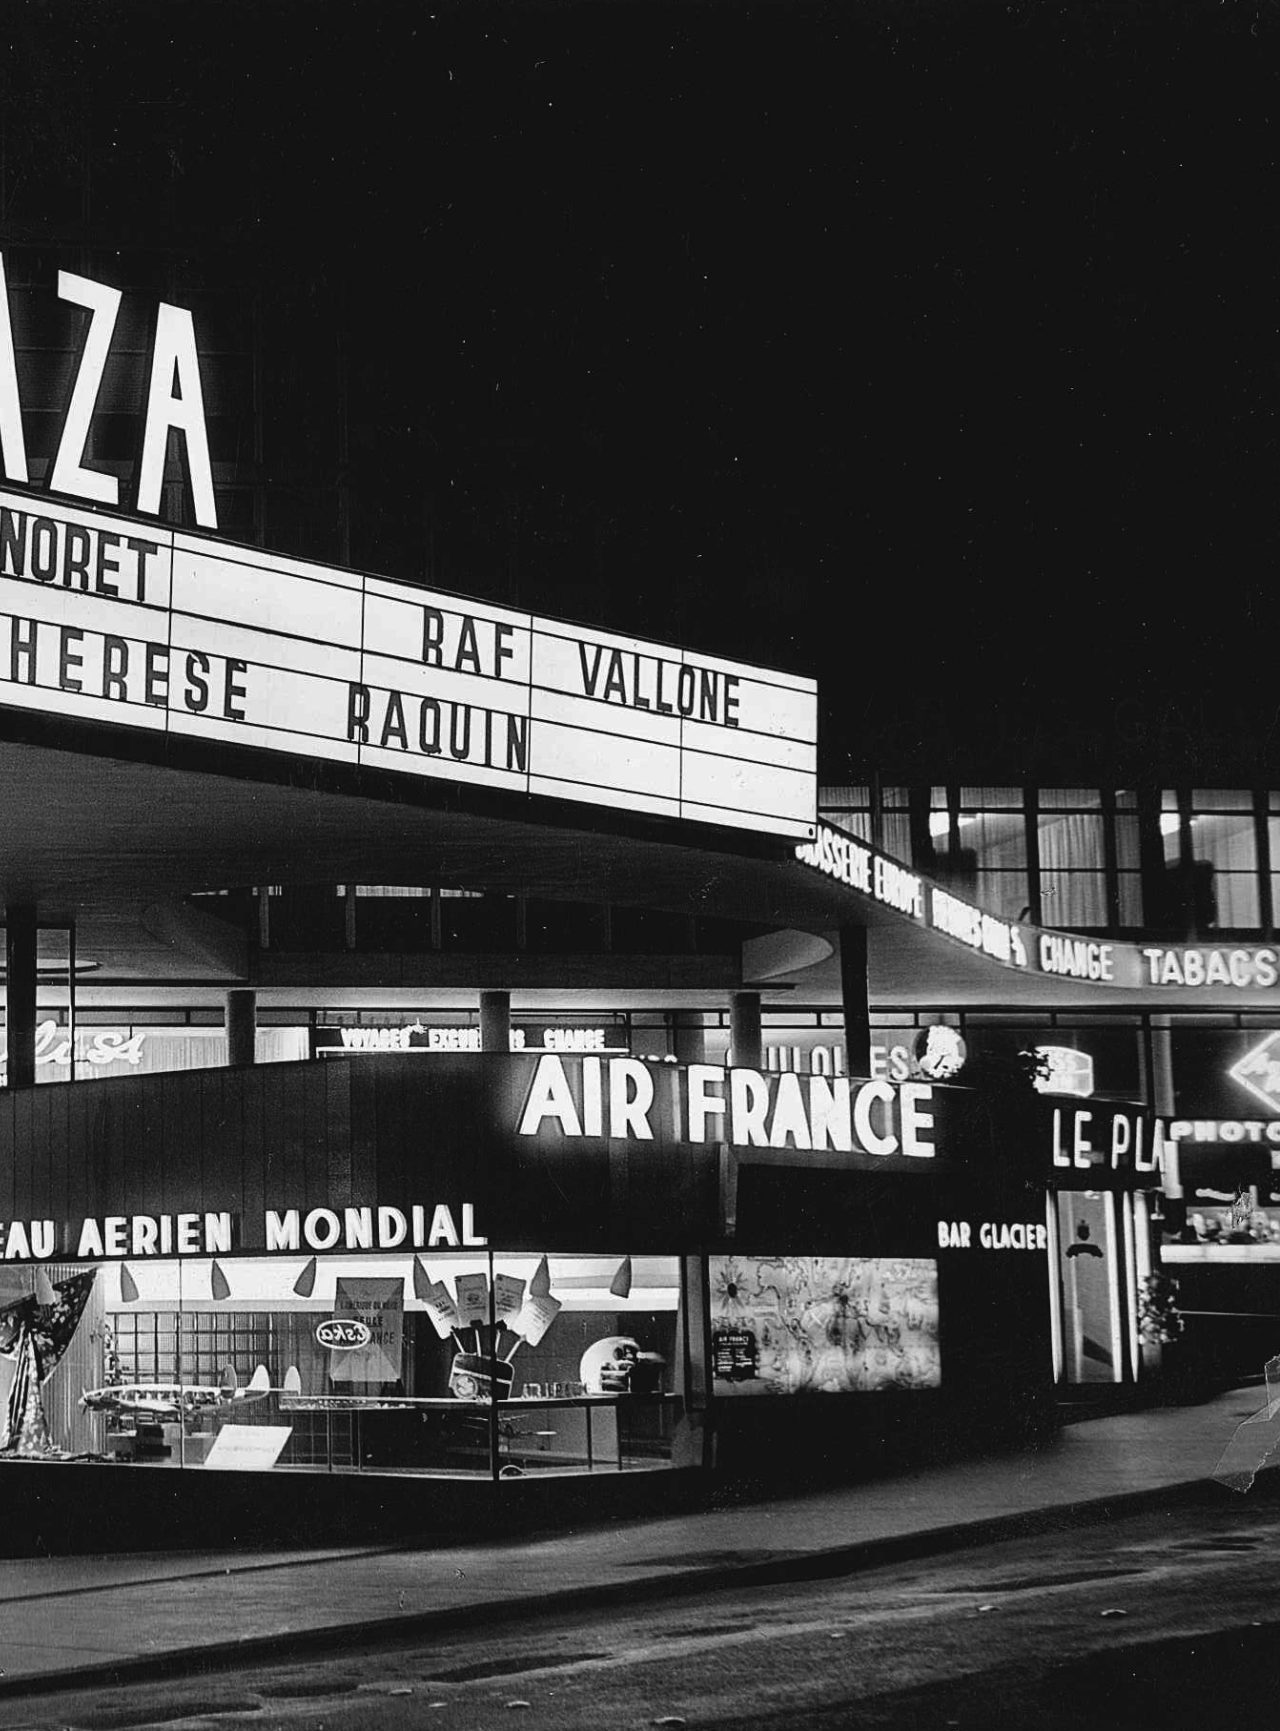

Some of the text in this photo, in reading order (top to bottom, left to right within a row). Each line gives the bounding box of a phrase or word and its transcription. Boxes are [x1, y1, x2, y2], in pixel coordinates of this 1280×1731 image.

[422, 606, 515, 679] RAF
[578, 640, 741, 727] VALLONE
[347, 681, 528, 772] RAQUIN
[1040, 933, 1114, 980] CHANGE
[1143, 948, 1279, 987] TABACS
[543, 1029, 606, 1048] CHANGE
[519, 1054, 654, 1140] AIR
[687, 1063, 936, 1158] FRANCE
[1053, 1108, 1092, 1168] LE
[77, 1211, 233, 1257] AERIEN
[265, 1203, 488, 1252] MONDIAL
[937, 1221, 1046, 1250] BAR GLACIER
